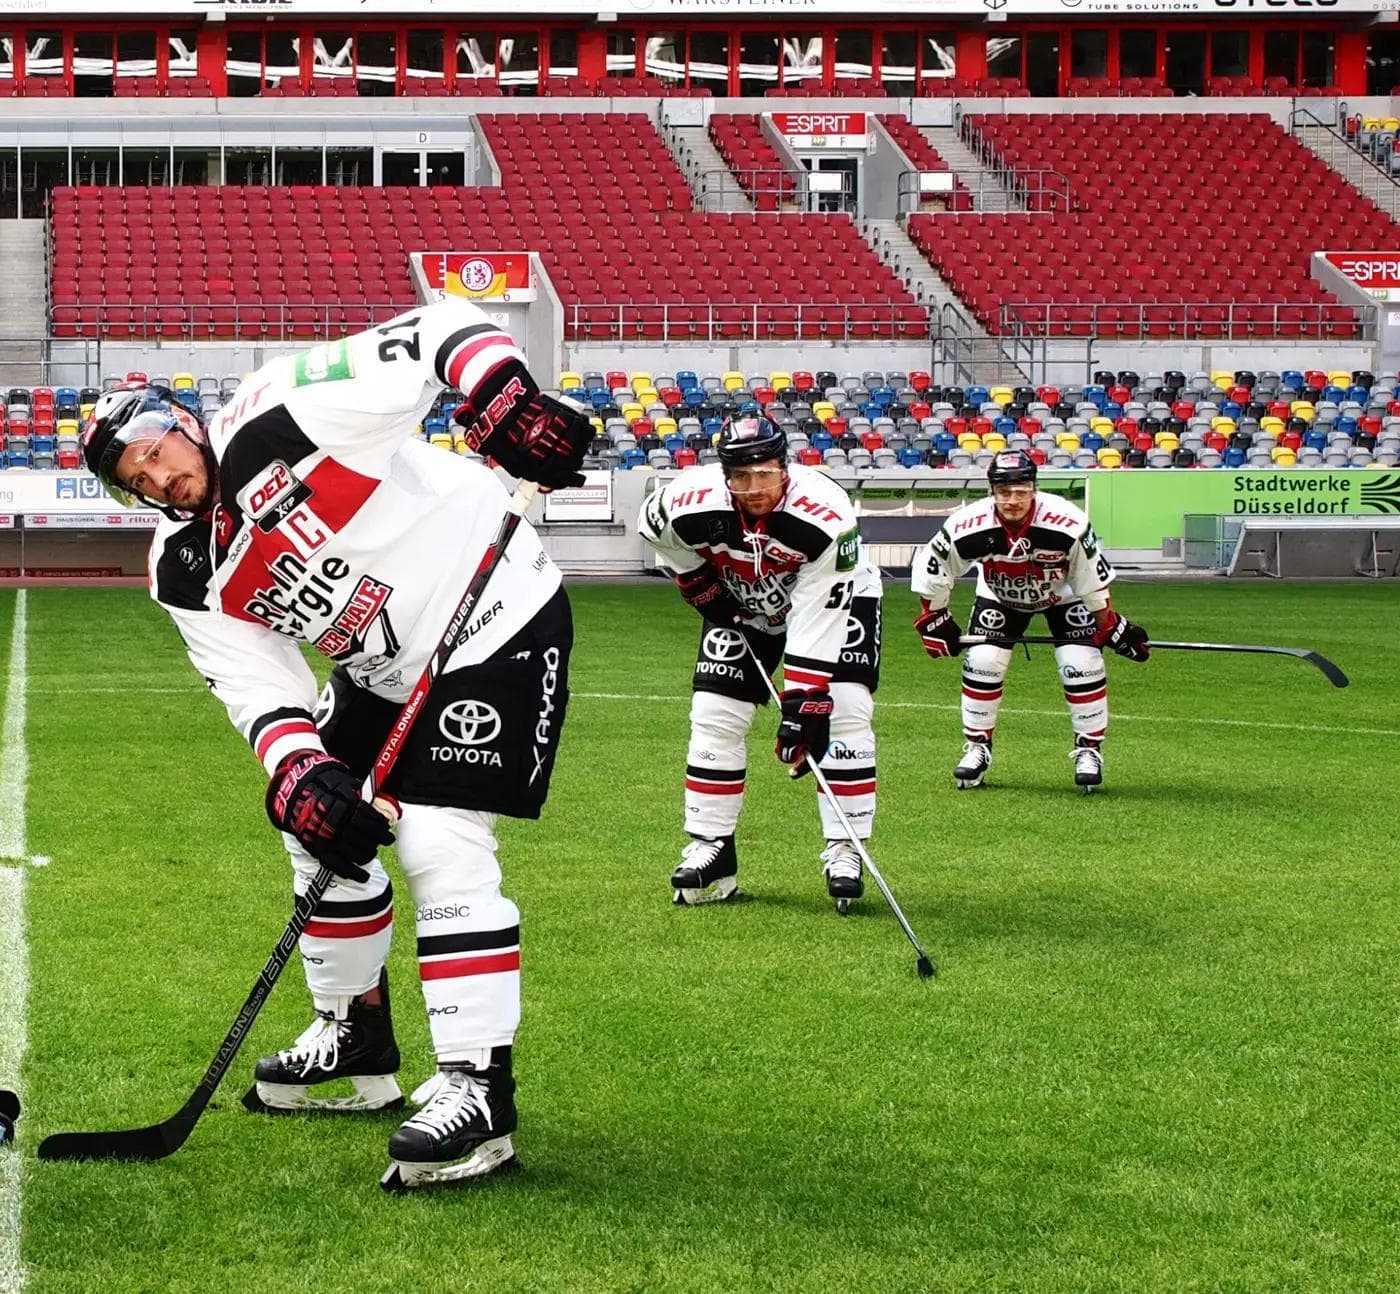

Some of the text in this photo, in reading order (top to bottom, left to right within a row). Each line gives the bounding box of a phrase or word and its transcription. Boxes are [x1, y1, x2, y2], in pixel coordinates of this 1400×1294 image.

[786, 115, 851, 132] ESPRIT
[418, 132, 427, 143] D
[841, 136, 847, 147] F
[378, 316, 422, 363] 21
[249, 471, 290, 514] DEL
[1233, 475, 1351, 492] Stadtwerke
[670, 487, 713, 512] HIT
[791, 495, 843, 522] HIT
[1233, 497, 1349, 514] Düsseldorf
[286, 509, 327, 551] C
[954, 513, 988, 534] HIT
[1041, 511, 1080, 528] HIT
[443, 592, 476, 649] BAUER
[454, 599, 505, 651] AUER
[696, 661, 745, 681] TOYOTA
[429, 745, 503, 768] TOYOTA
